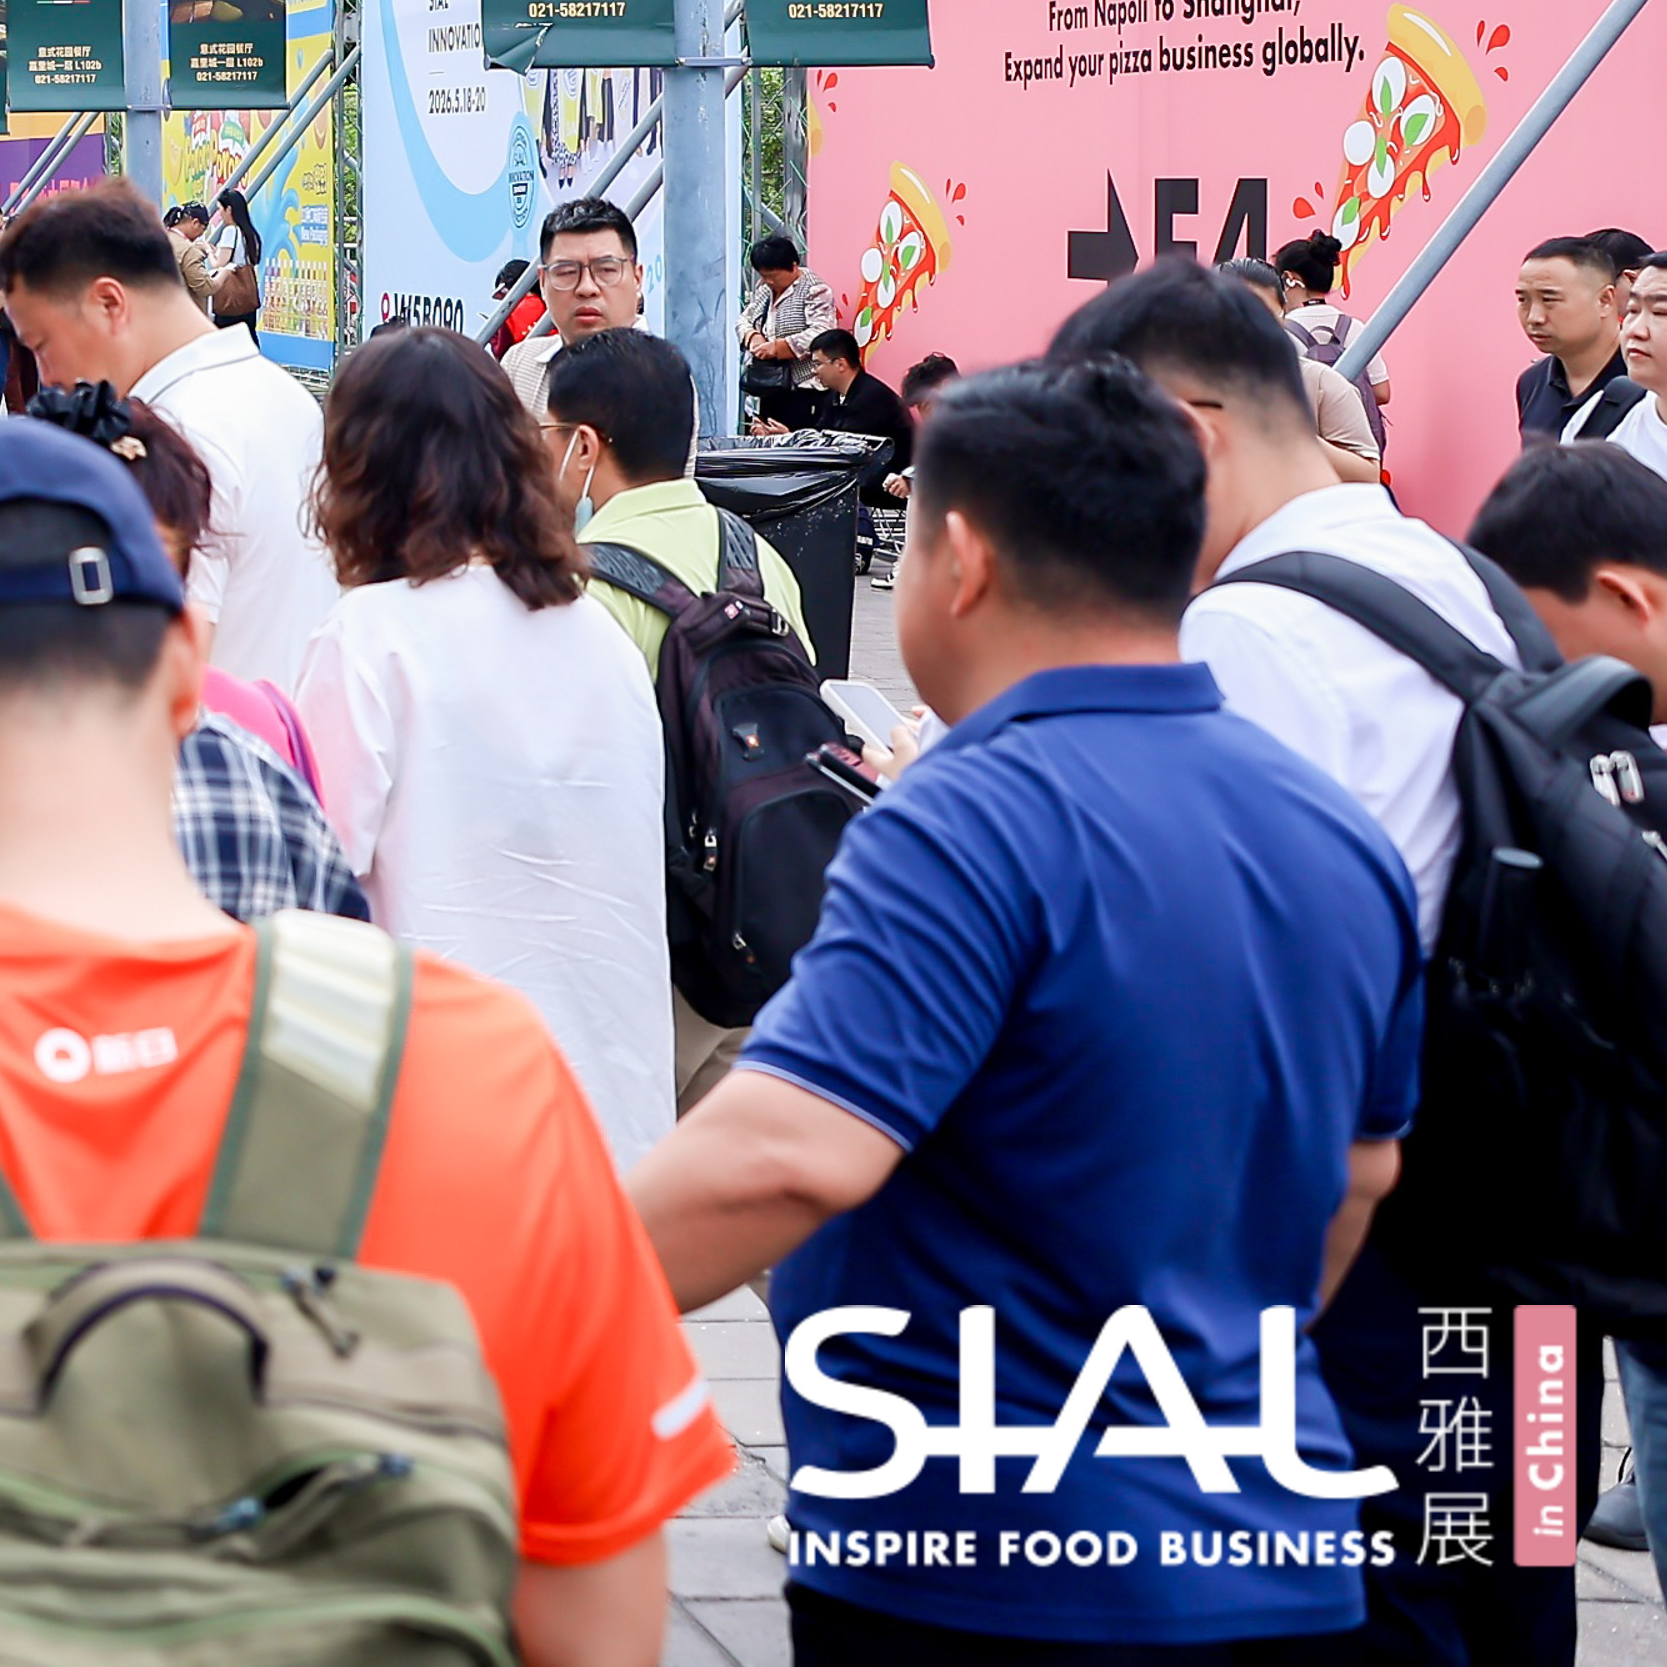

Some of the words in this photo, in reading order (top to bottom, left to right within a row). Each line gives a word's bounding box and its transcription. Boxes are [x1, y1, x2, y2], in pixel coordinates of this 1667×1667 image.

[528, 0, 626, 19] 021-58217117
[429, 23, 484, 52] INNOVATIO
[1004, 45, 1063, 90] Expand
[1068, 51, 1104, 86] your
[1109, 43, 1153, 82] pizza
[1159, 34, 1254, 74] business
[1261, 24, 1366, 76] globally.
[35, 74, 96, 84] 021-58217117
[196, 71, 257, 81] 021-58217117
[429, 87, 486, 114] 2026.5.18-20
